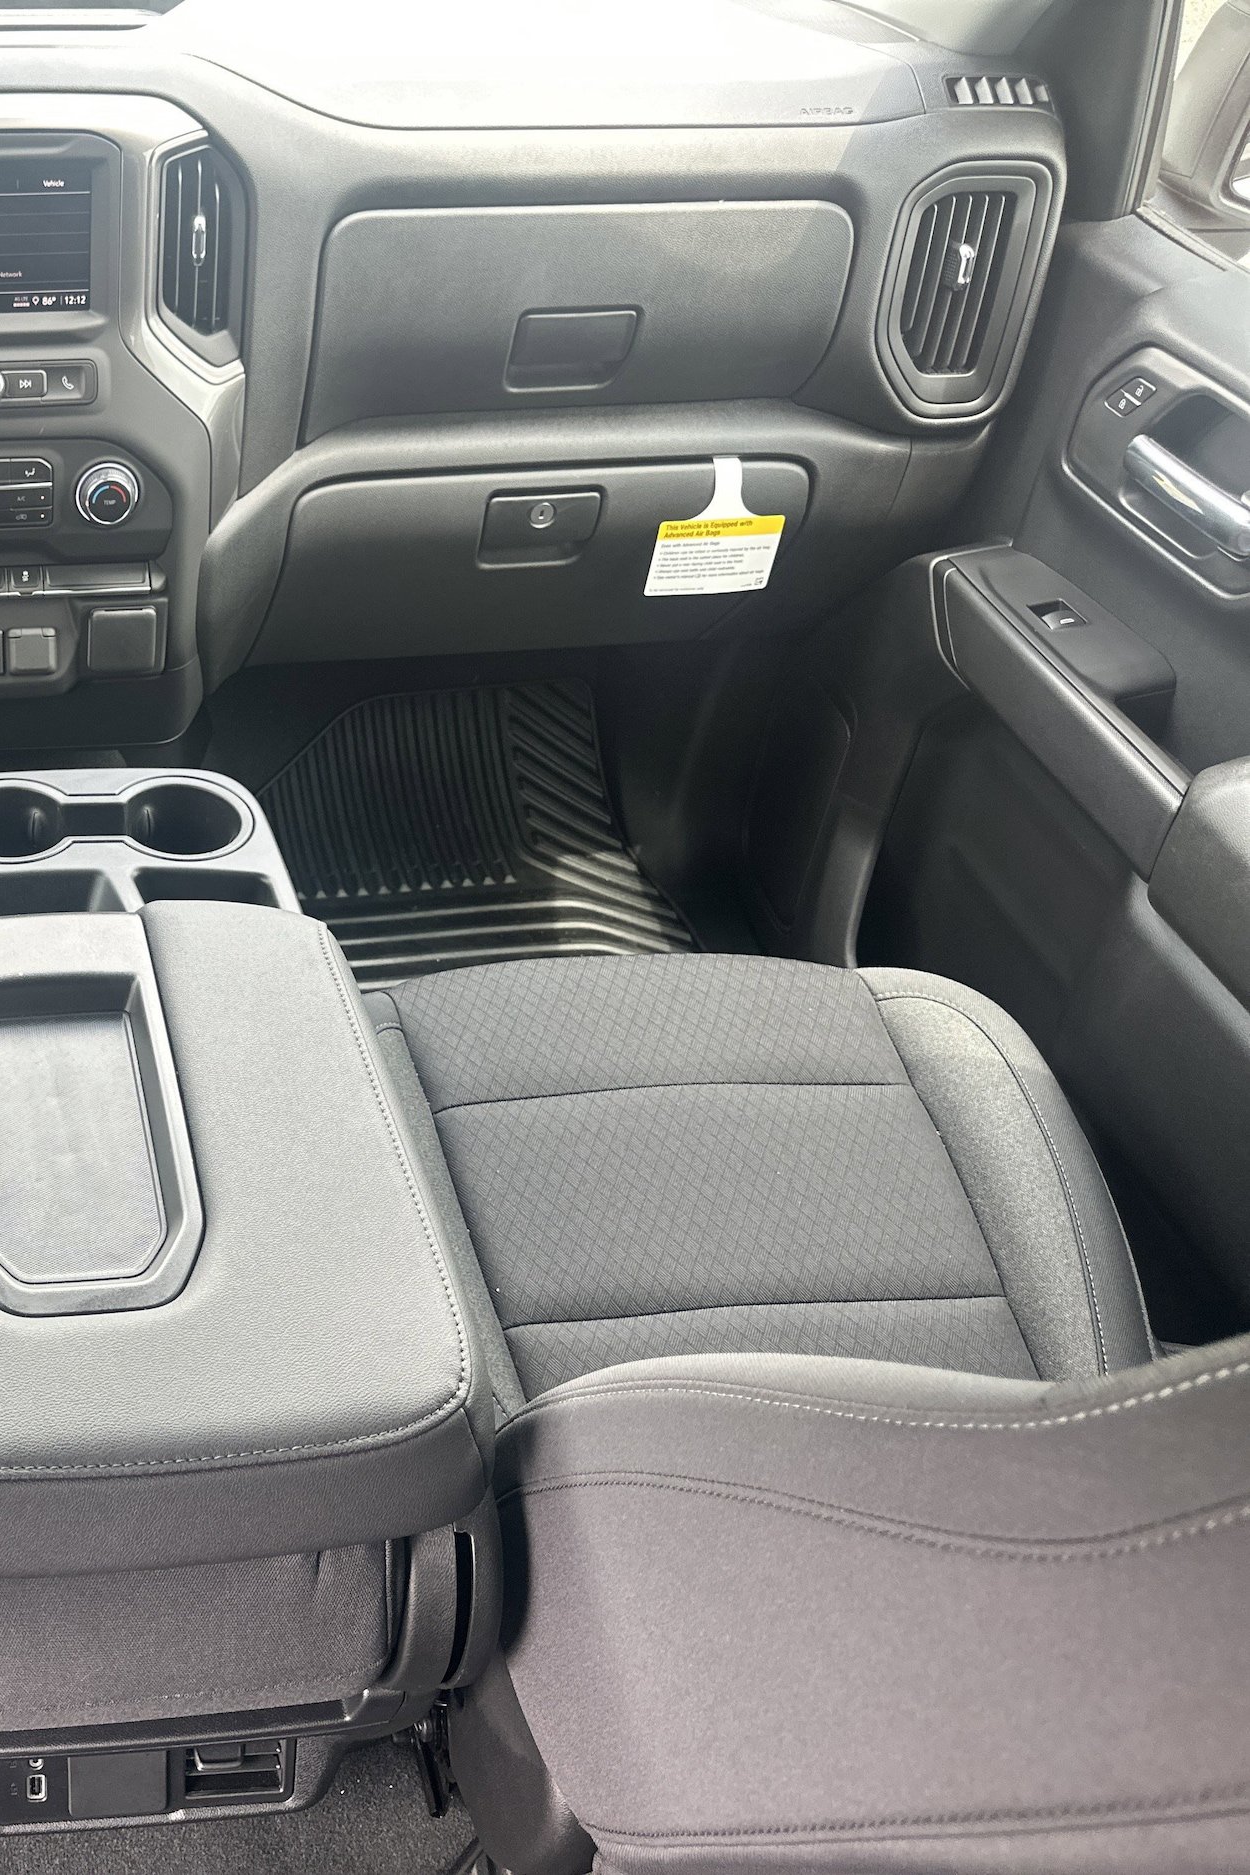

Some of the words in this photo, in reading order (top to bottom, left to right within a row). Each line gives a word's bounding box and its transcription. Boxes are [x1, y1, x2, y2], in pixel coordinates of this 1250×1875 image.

[800, 107, 853, 116] AIRBAG
[42, 180, 65, 188] Vehicle
[64, 295, 86, 305] 12:12
[710, 520, 738, 529] Equipped
